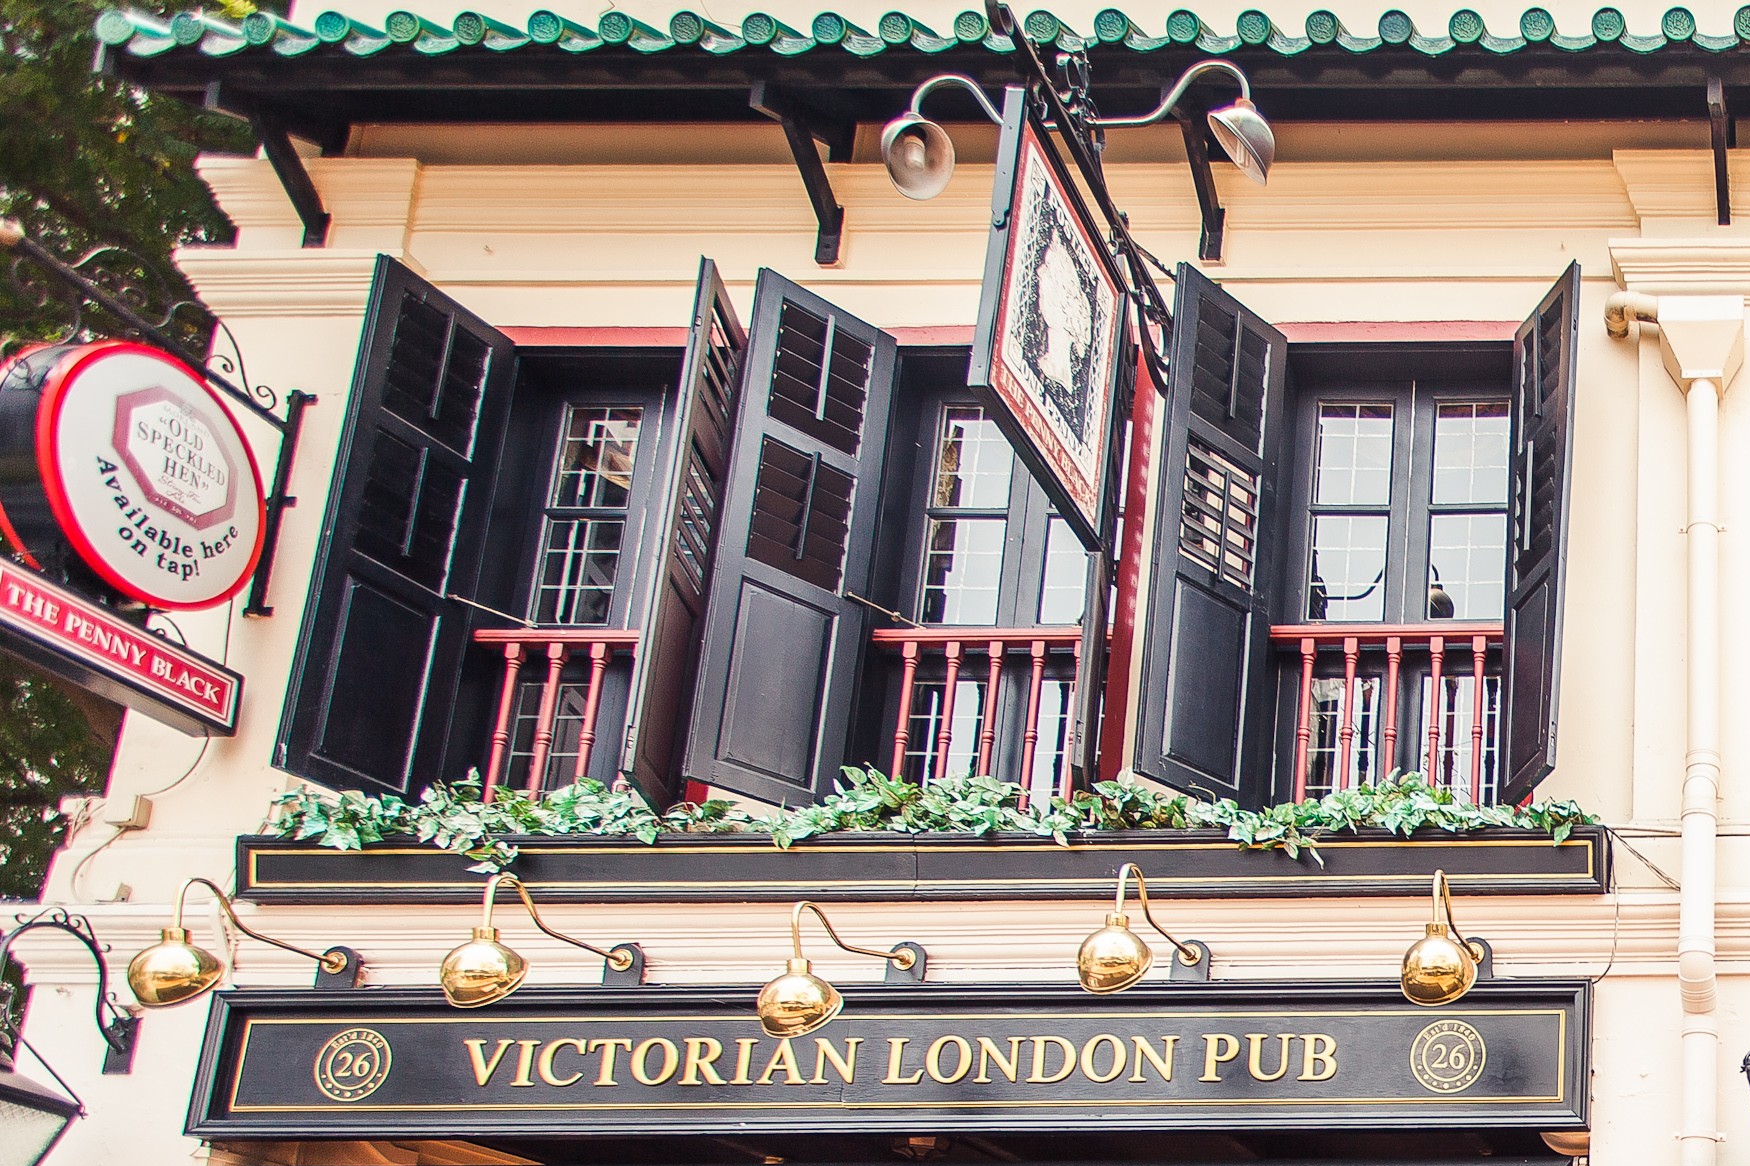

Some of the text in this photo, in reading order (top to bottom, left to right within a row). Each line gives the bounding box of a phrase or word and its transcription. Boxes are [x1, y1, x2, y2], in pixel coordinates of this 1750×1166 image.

[137, 421, 225, 487] SPECKLED
[1000, 366, 1097, 499] THE PENNY BLACK
[97, 456, 239, 559] Available here
[119, 525, 200, 581] on tap!
[7, 581, 220, 705] THE PENNY BLACK
[463, 1030, 1339, 1087] VICTORIAN LONDON PUB
[1431, 1043, 1466, 1070] 26
[1452, 1023, 1476, 1041] 1840
[334, 1051, 373, 1077] 26
